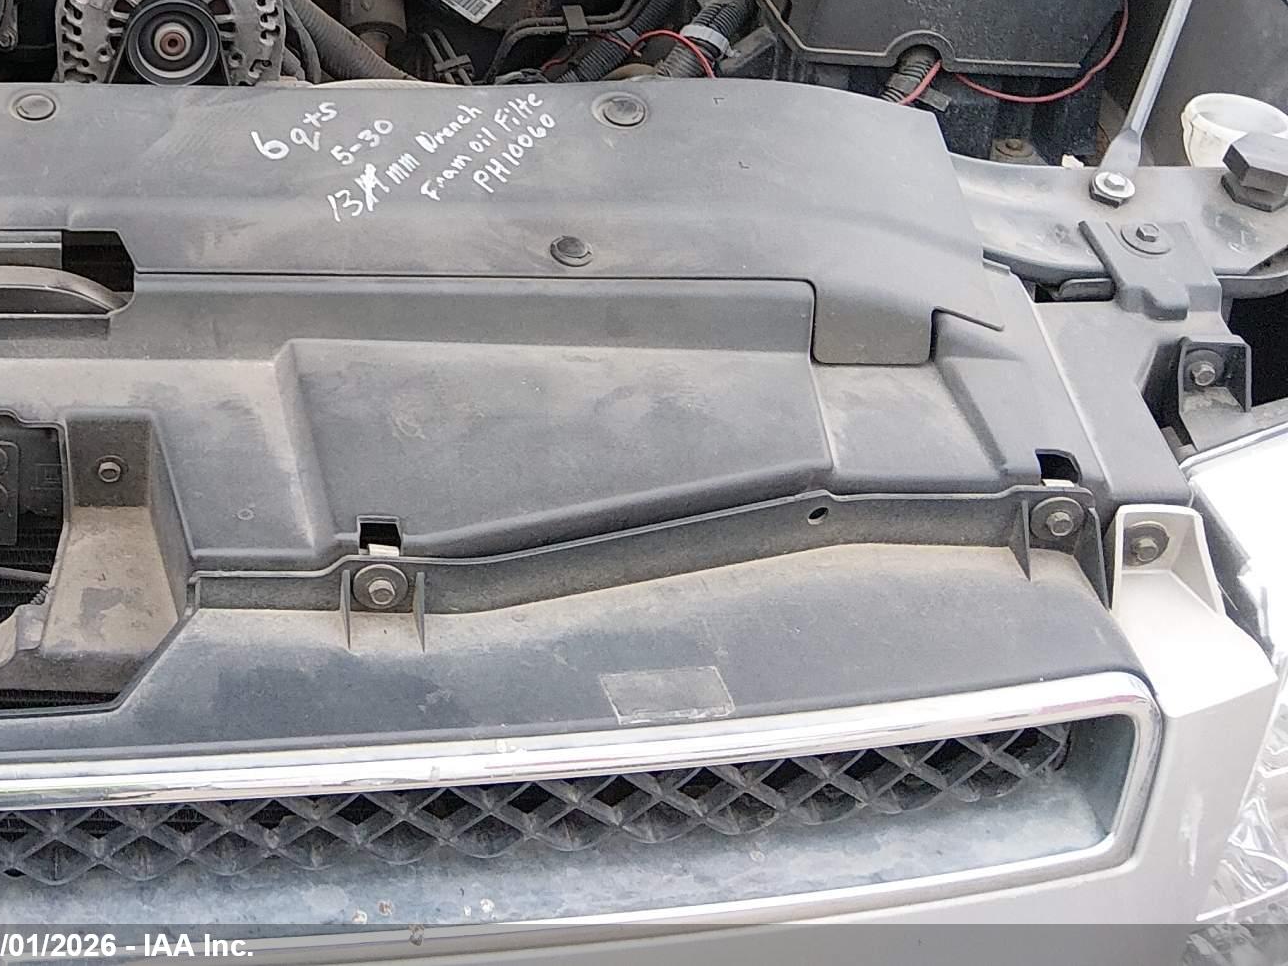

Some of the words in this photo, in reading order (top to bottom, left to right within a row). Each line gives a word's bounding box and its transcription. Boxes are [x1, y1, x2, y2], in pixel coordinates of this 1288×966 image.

[250, 130, 290, 160] 6
[330, 119, 394, 165] 5-30
[473, 113, 555, 193] PH10060
